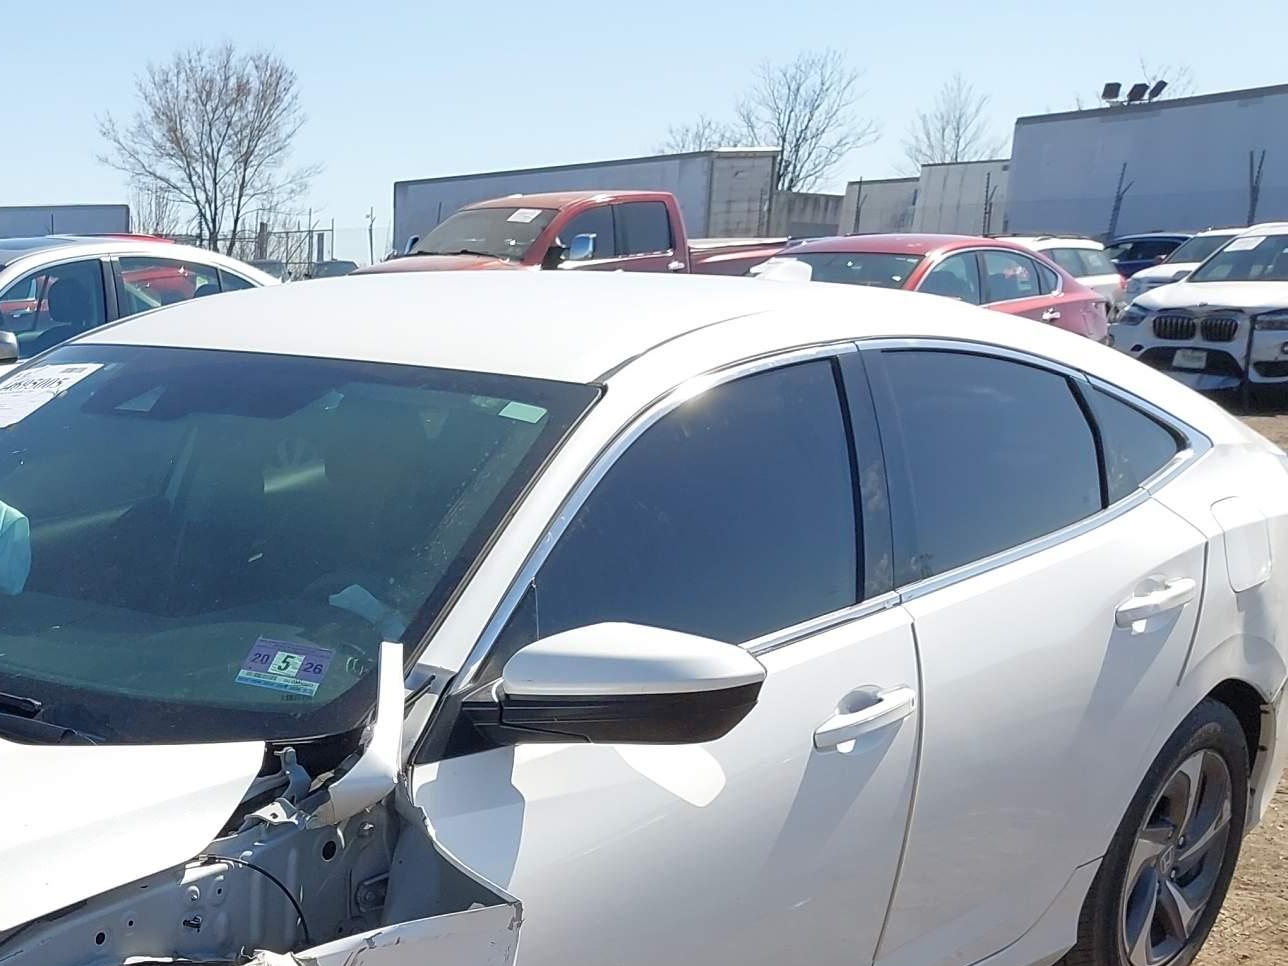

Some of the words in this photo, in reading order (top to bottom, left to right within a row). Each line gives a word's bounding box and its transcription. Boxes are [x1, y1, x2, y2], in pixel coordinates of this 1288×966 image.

[251, 653, 270, 664] 20
[277, 655, 296, 671] 5
[303, 662, 324, 674] 26
